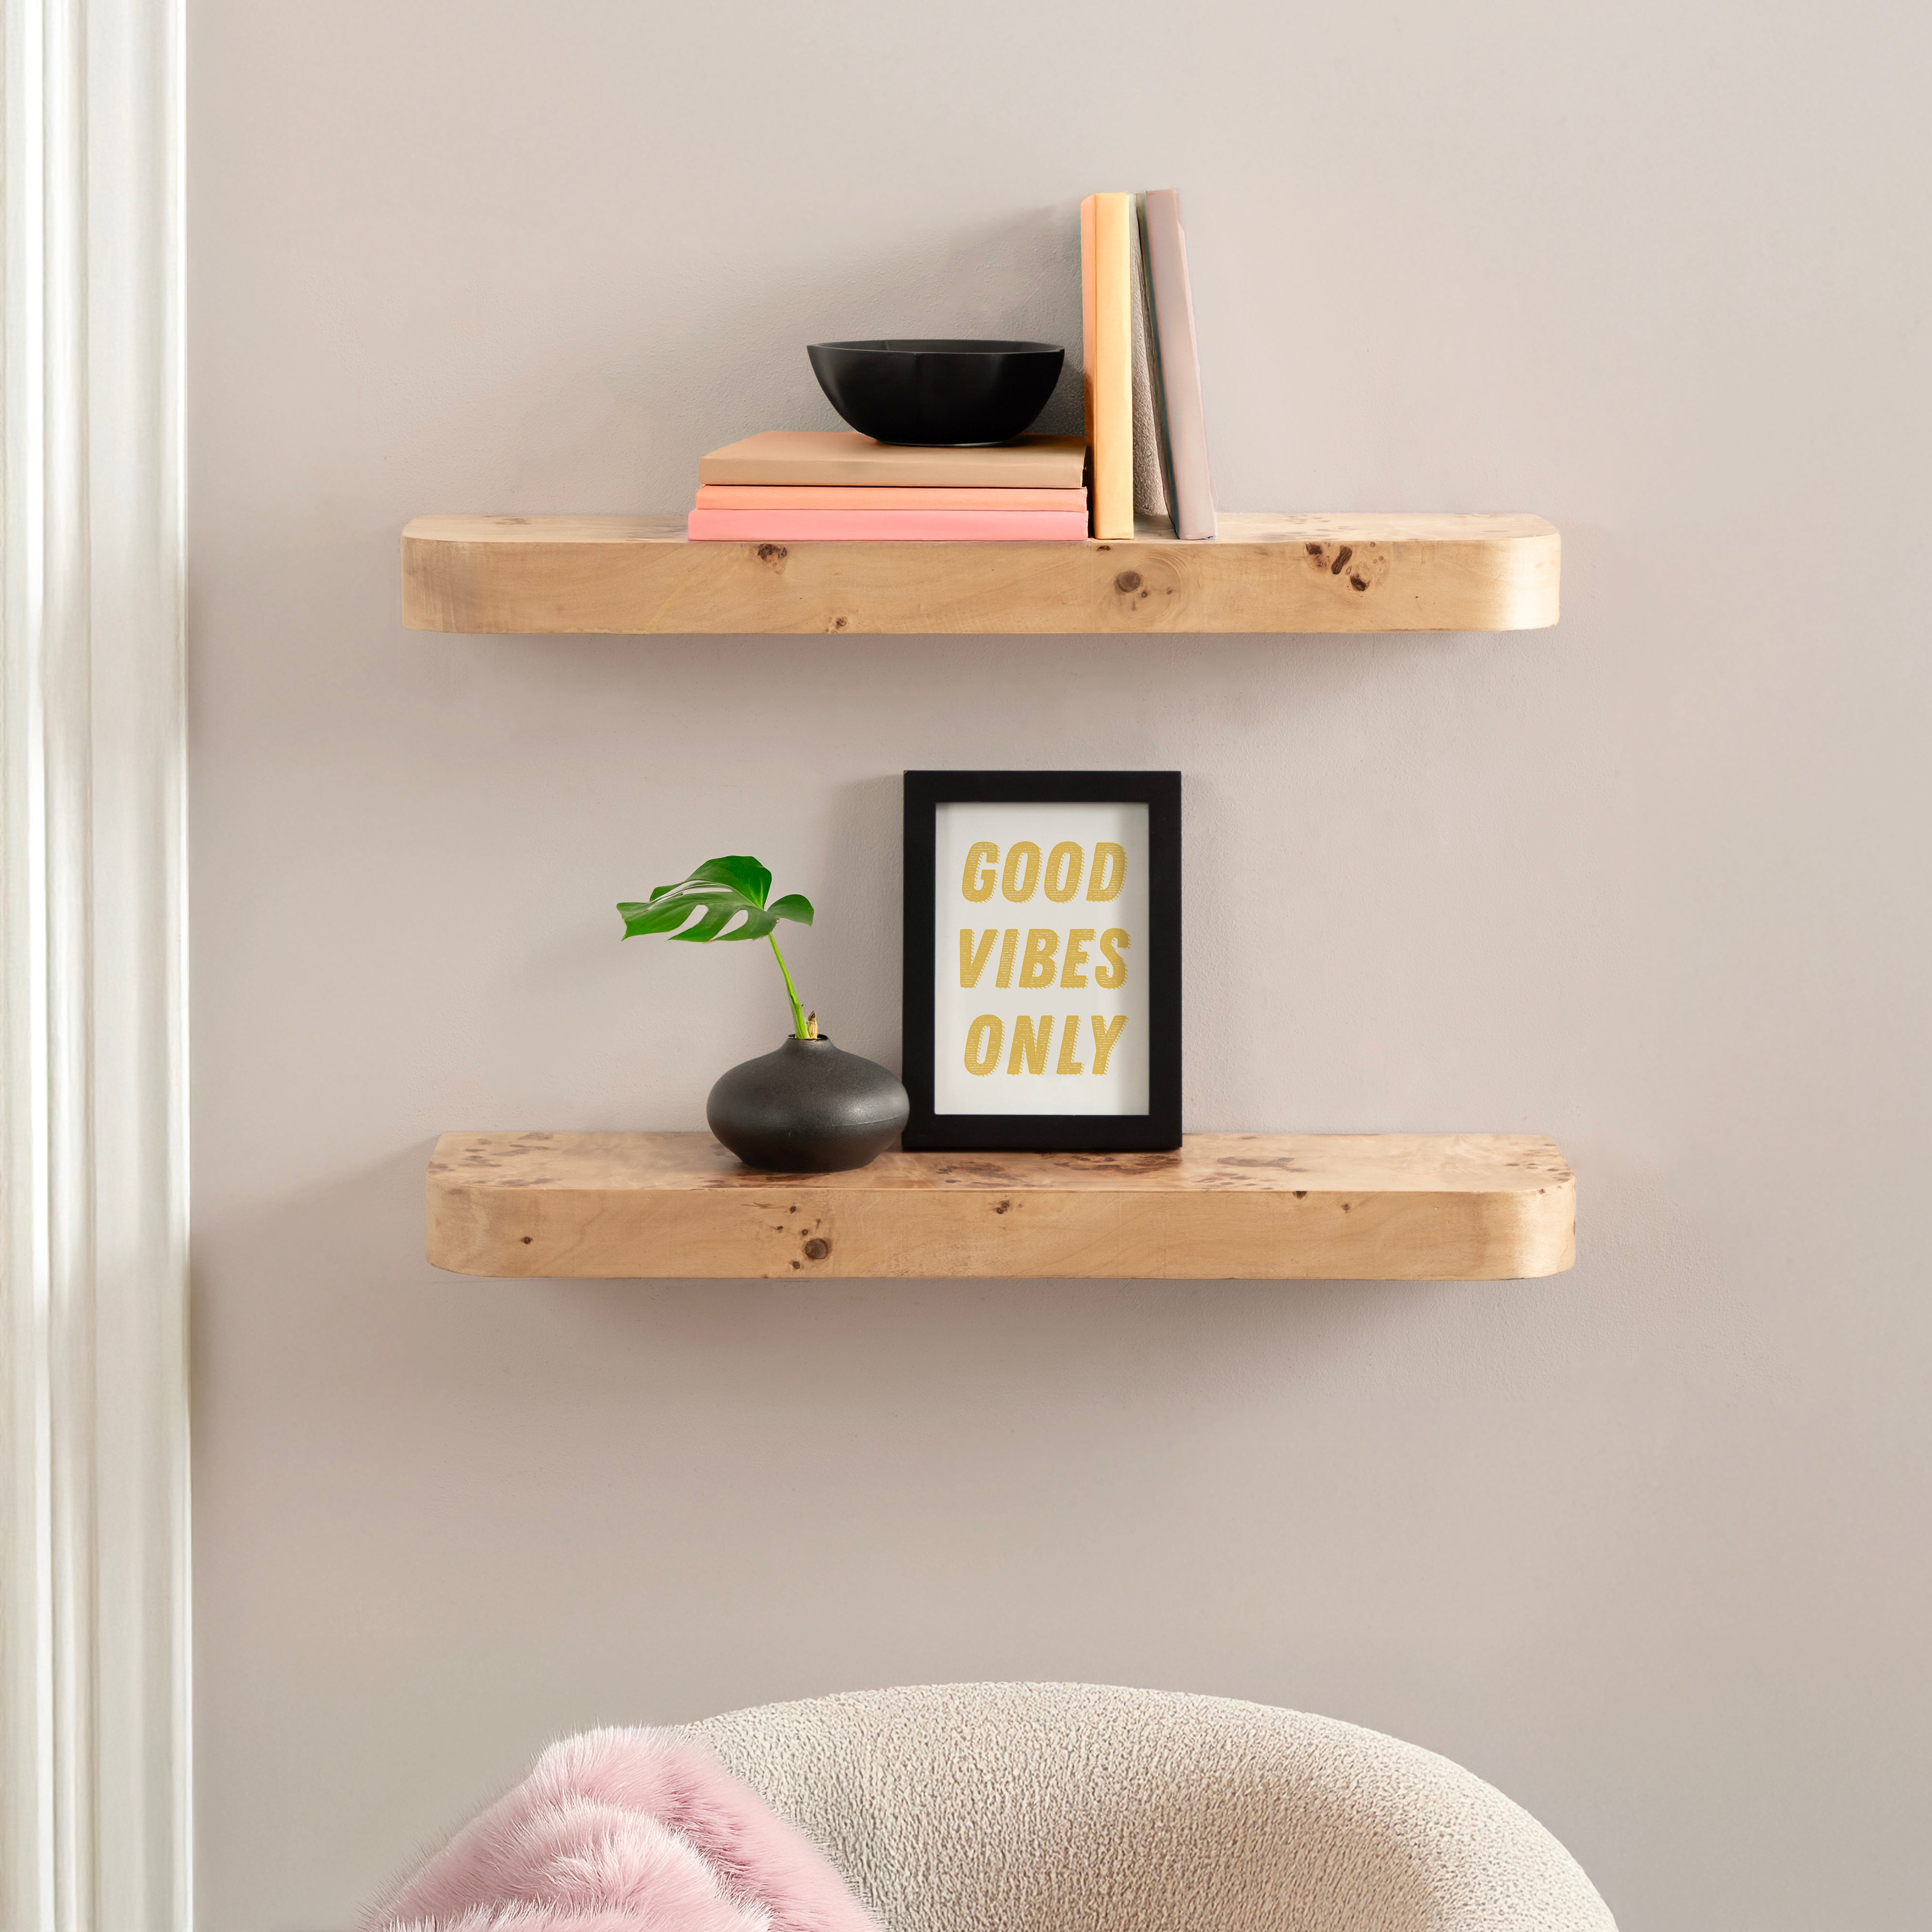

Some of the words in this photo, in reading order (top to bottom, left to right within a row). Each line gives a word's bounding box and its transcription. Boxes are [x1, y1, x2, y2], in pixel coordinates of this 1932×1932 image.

[961, 841, 1127, 904] GOOD
[959, 928, 1131, 990] VIBES
[964, 1014, 1129, 1077] ONLY
